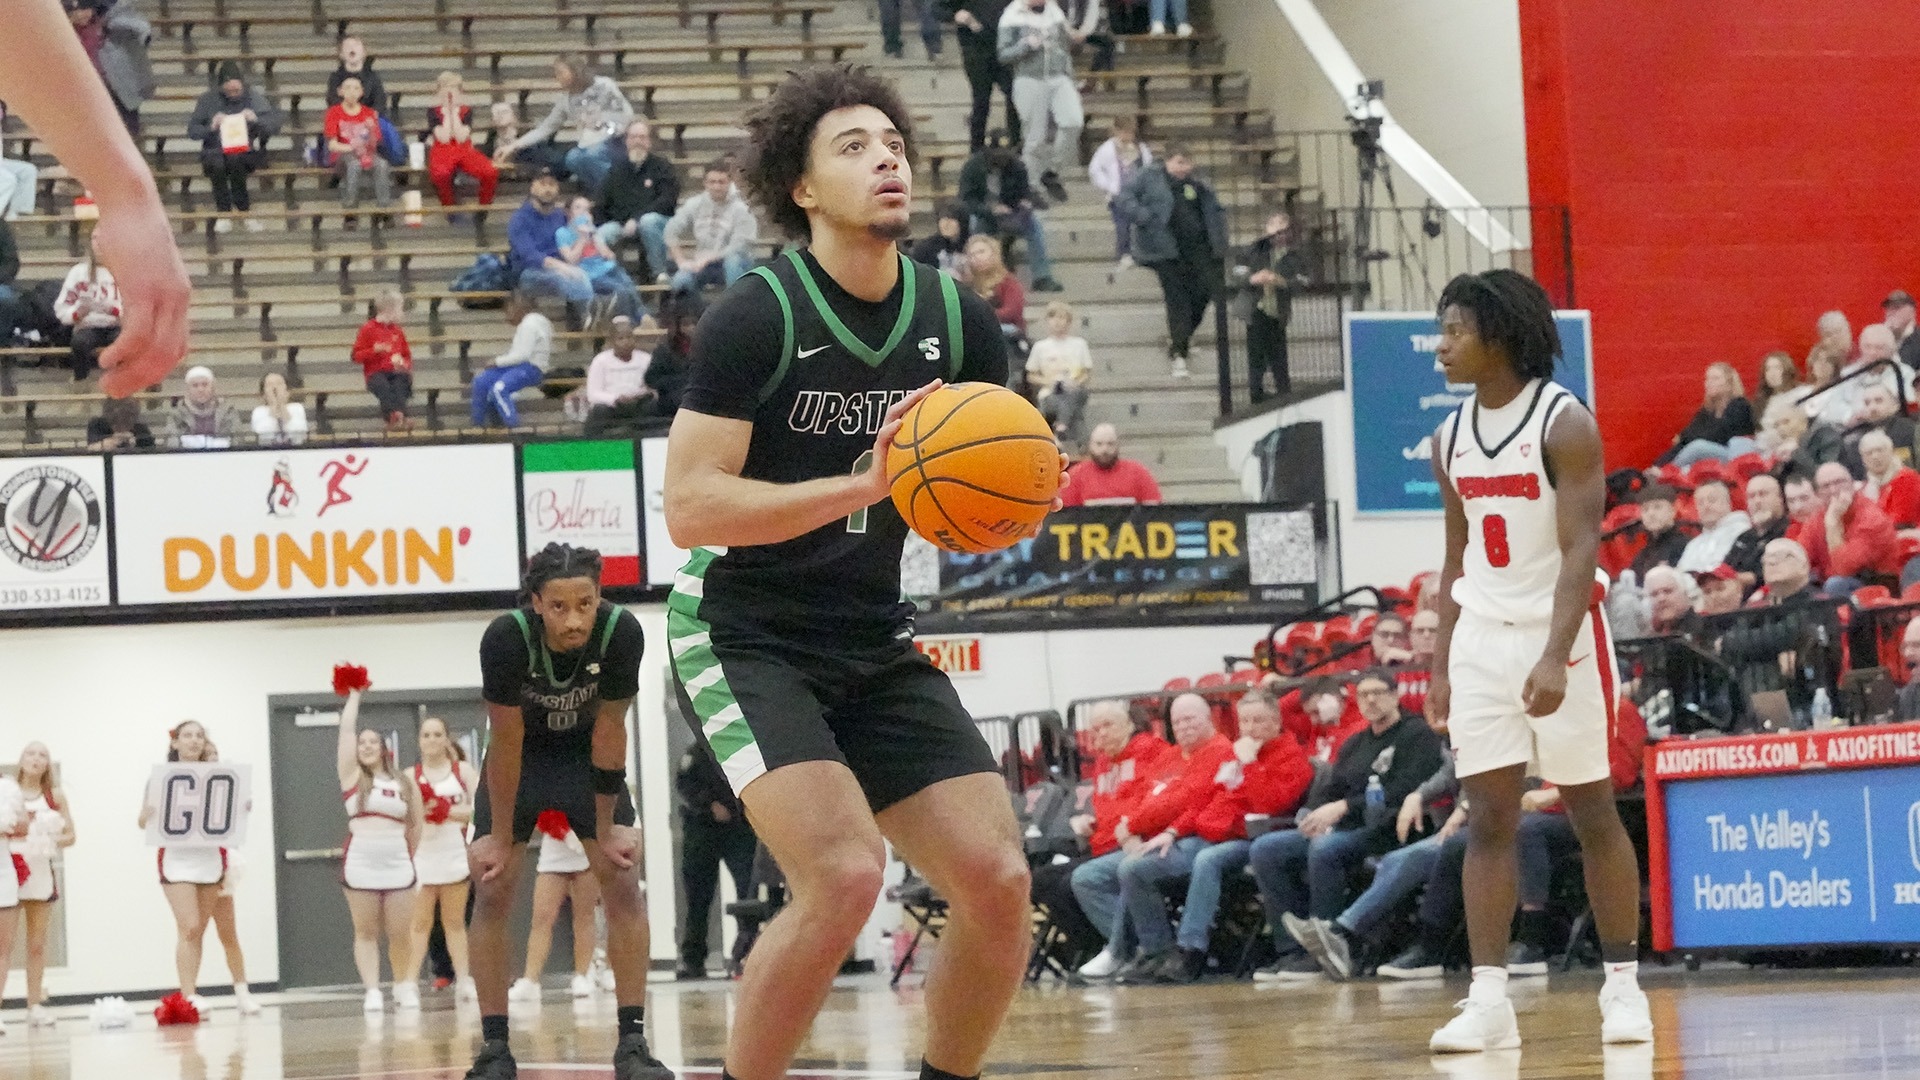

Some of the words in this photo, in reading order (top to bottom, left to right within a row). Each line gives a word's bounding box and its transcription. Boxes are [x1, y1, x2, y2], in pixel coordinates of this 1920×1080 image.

[788, 390, 915, 435] UPST
[528, 478, 623, 533] Belleria
[163, 526, 472, 593] DUNKIN'
[1049, 519, 1240, 562] TRADER
[3, 587, 100, 604] 330-533-4125
[922, 640, 976, 672] EXIT
[521, 682, 599, 711] UPSTAT
[1656, 742, 1799, 775] AXIOFITNESS.COM
[162, 772, 236, 838] GO
[1706, 812, 1748, 853] The
[1751, 809, 1831, 860] Valley's
[1693, 870, 1765, 911] Honda
[1769, 866, 1852, 908] Dealers
